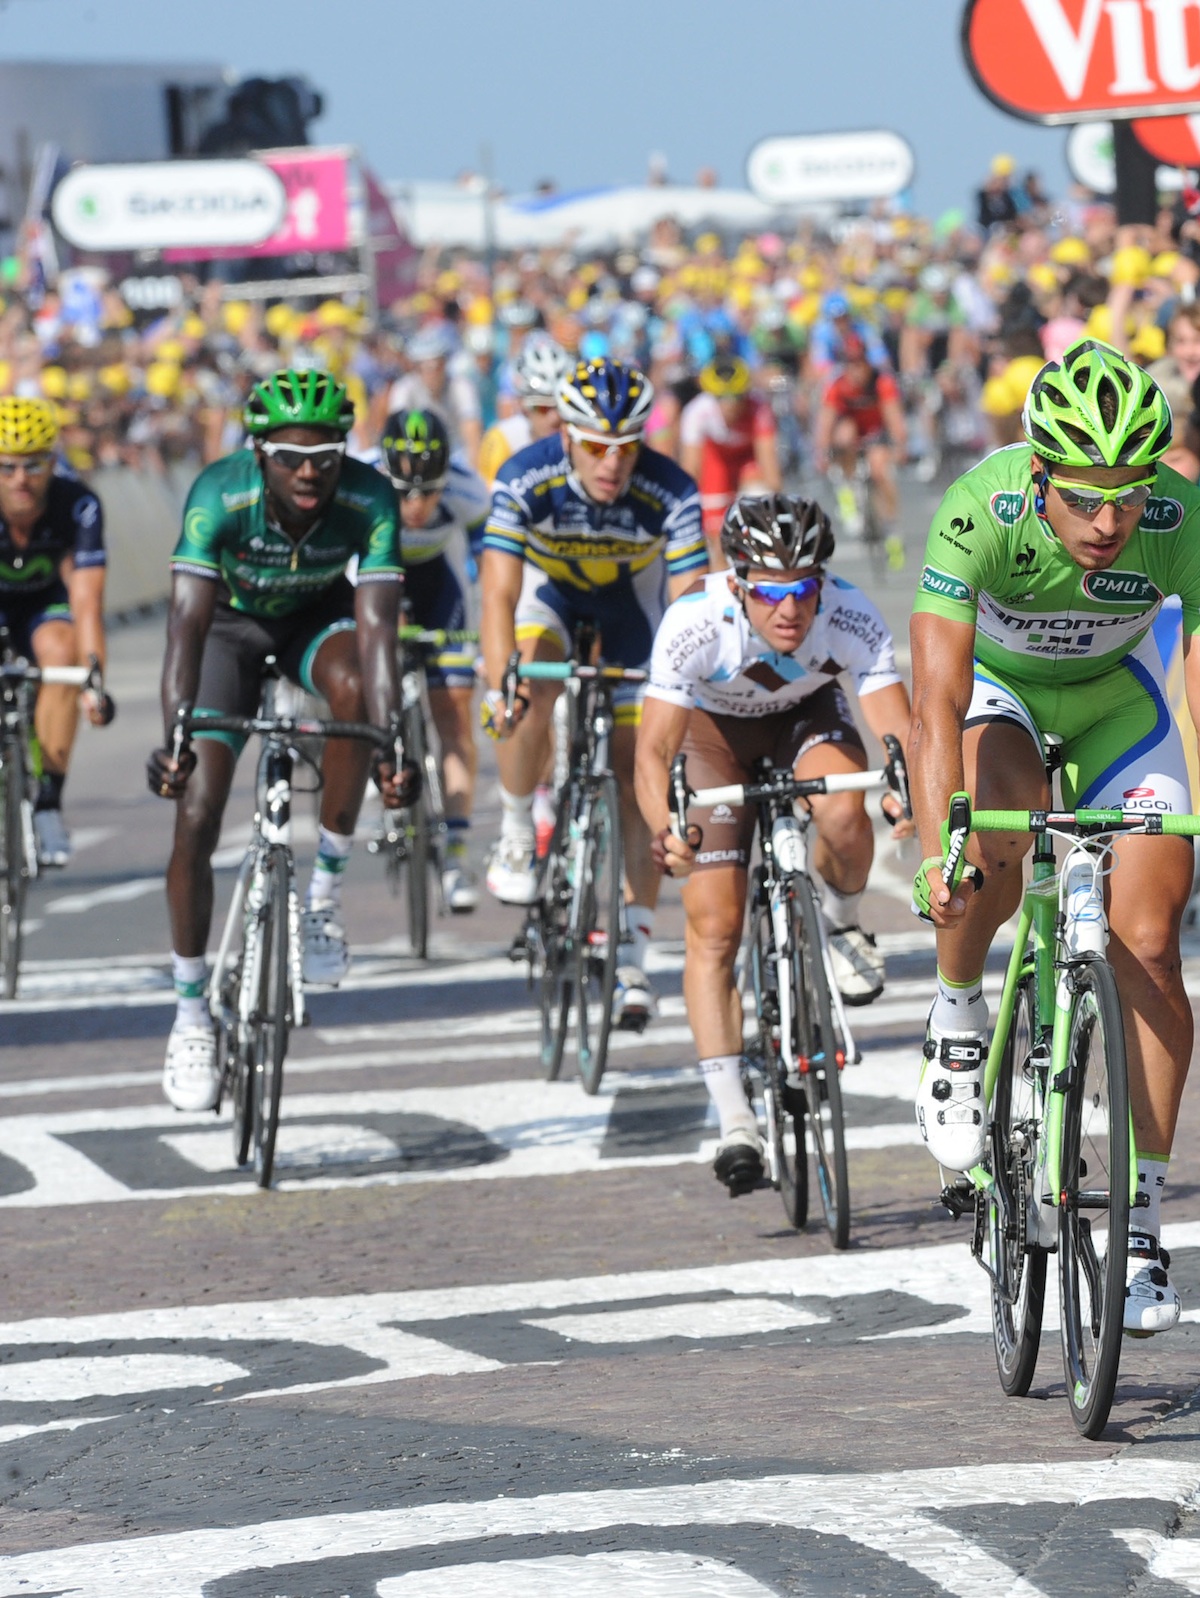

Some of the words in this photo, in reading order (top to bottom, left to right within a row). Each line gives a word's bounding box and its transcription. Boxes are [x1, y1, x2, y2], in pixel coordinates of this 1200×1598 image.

[1092, 577, 1139, 595] PMU
[833, 605, 871, 627] AG2R
[665, 627, 695, 658] AG2R
[699, 618, 713, 631] LA
[942, 832, 965, 884] RAM
[948, 1046, 980, 1061] SIDI
